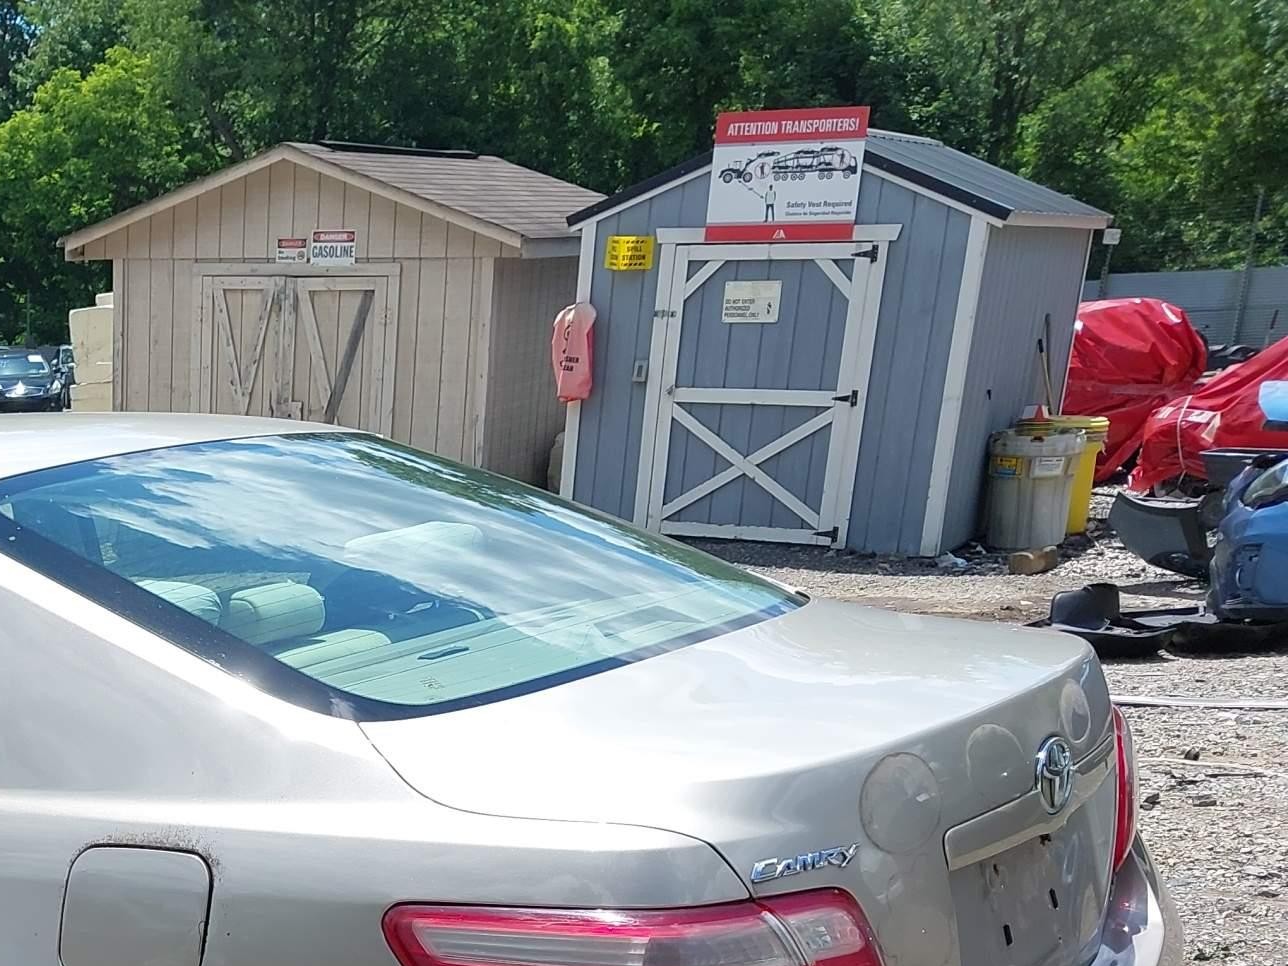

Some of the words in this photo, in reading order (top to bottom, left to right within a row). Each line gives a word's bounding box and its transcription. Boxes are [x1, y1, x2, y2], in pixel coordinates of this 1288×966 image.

[727, 120, 778, 136] ATTENTION
[780, 118, 860, 134] TRANSPORTERS!
[786, 200, 807, 208] Safety
[808, 200, 822, 208] Vest
[823, 199, 853, 208] Required
[312, 244, 354, 258] GASOLINE
[751, 842, 859, 883] CAMRY
